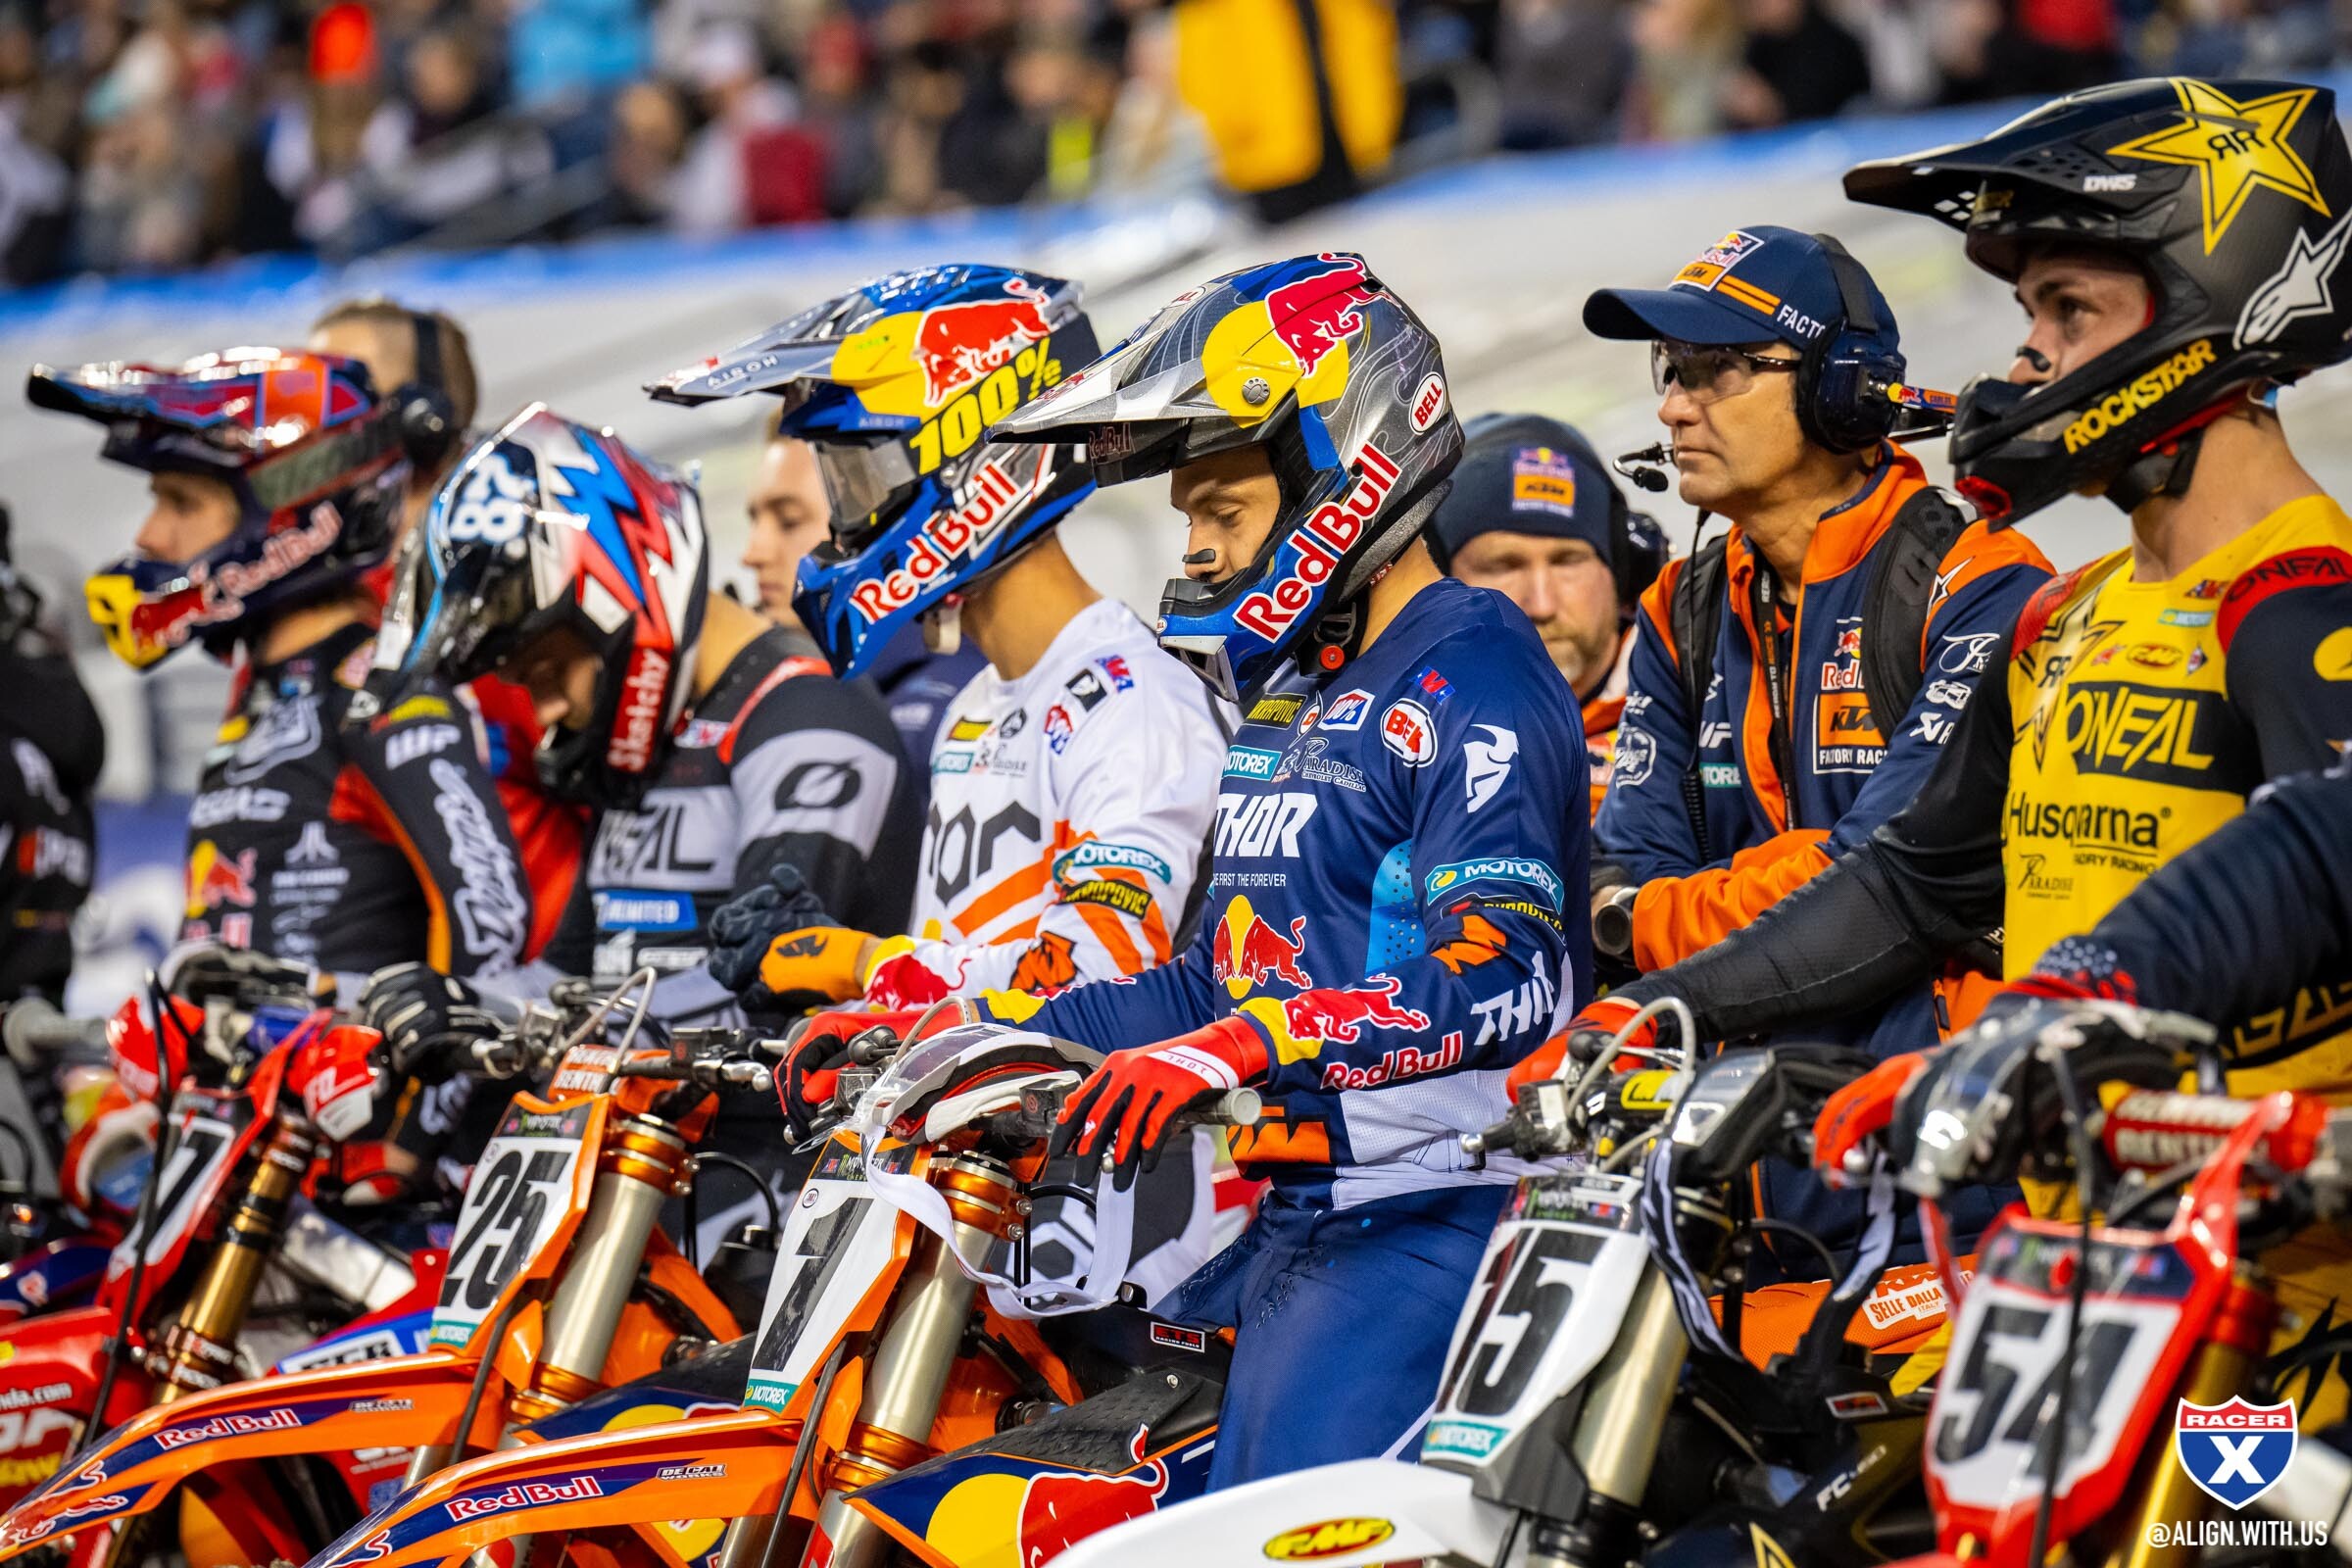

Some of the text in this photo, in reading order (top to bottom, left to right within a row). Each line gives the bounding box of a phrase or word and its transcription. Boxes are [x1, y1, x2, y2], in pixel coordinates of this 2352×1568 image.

[1767, 304, 1826, 339] FACT
[707, 354, 779, 390] AIROH
[909, 336, 1062, 476] 100%
[1414, 382, 1443, 427] BELL
[1237, 873, 1250, 887] THE
[1250, 873, 1287, 887] FOREVER
[1464, 859, 1558, 902] MOTOREX
[1320, 1031, 1463, 1091] Red Bull
[438, 1150, 573, 1311] 25
[1438, 1227, 1609, 1417] 15
[1869, 1287, 1943, 1323] SELLE DALLA
[1917, 1300, 1940, 1313] ITALY
[751, 1384, 789, 1406] MOTOREX
[153, 1407, 303, 1451] Red Bull
[445, 1476, 605, 1523] Red Bull
